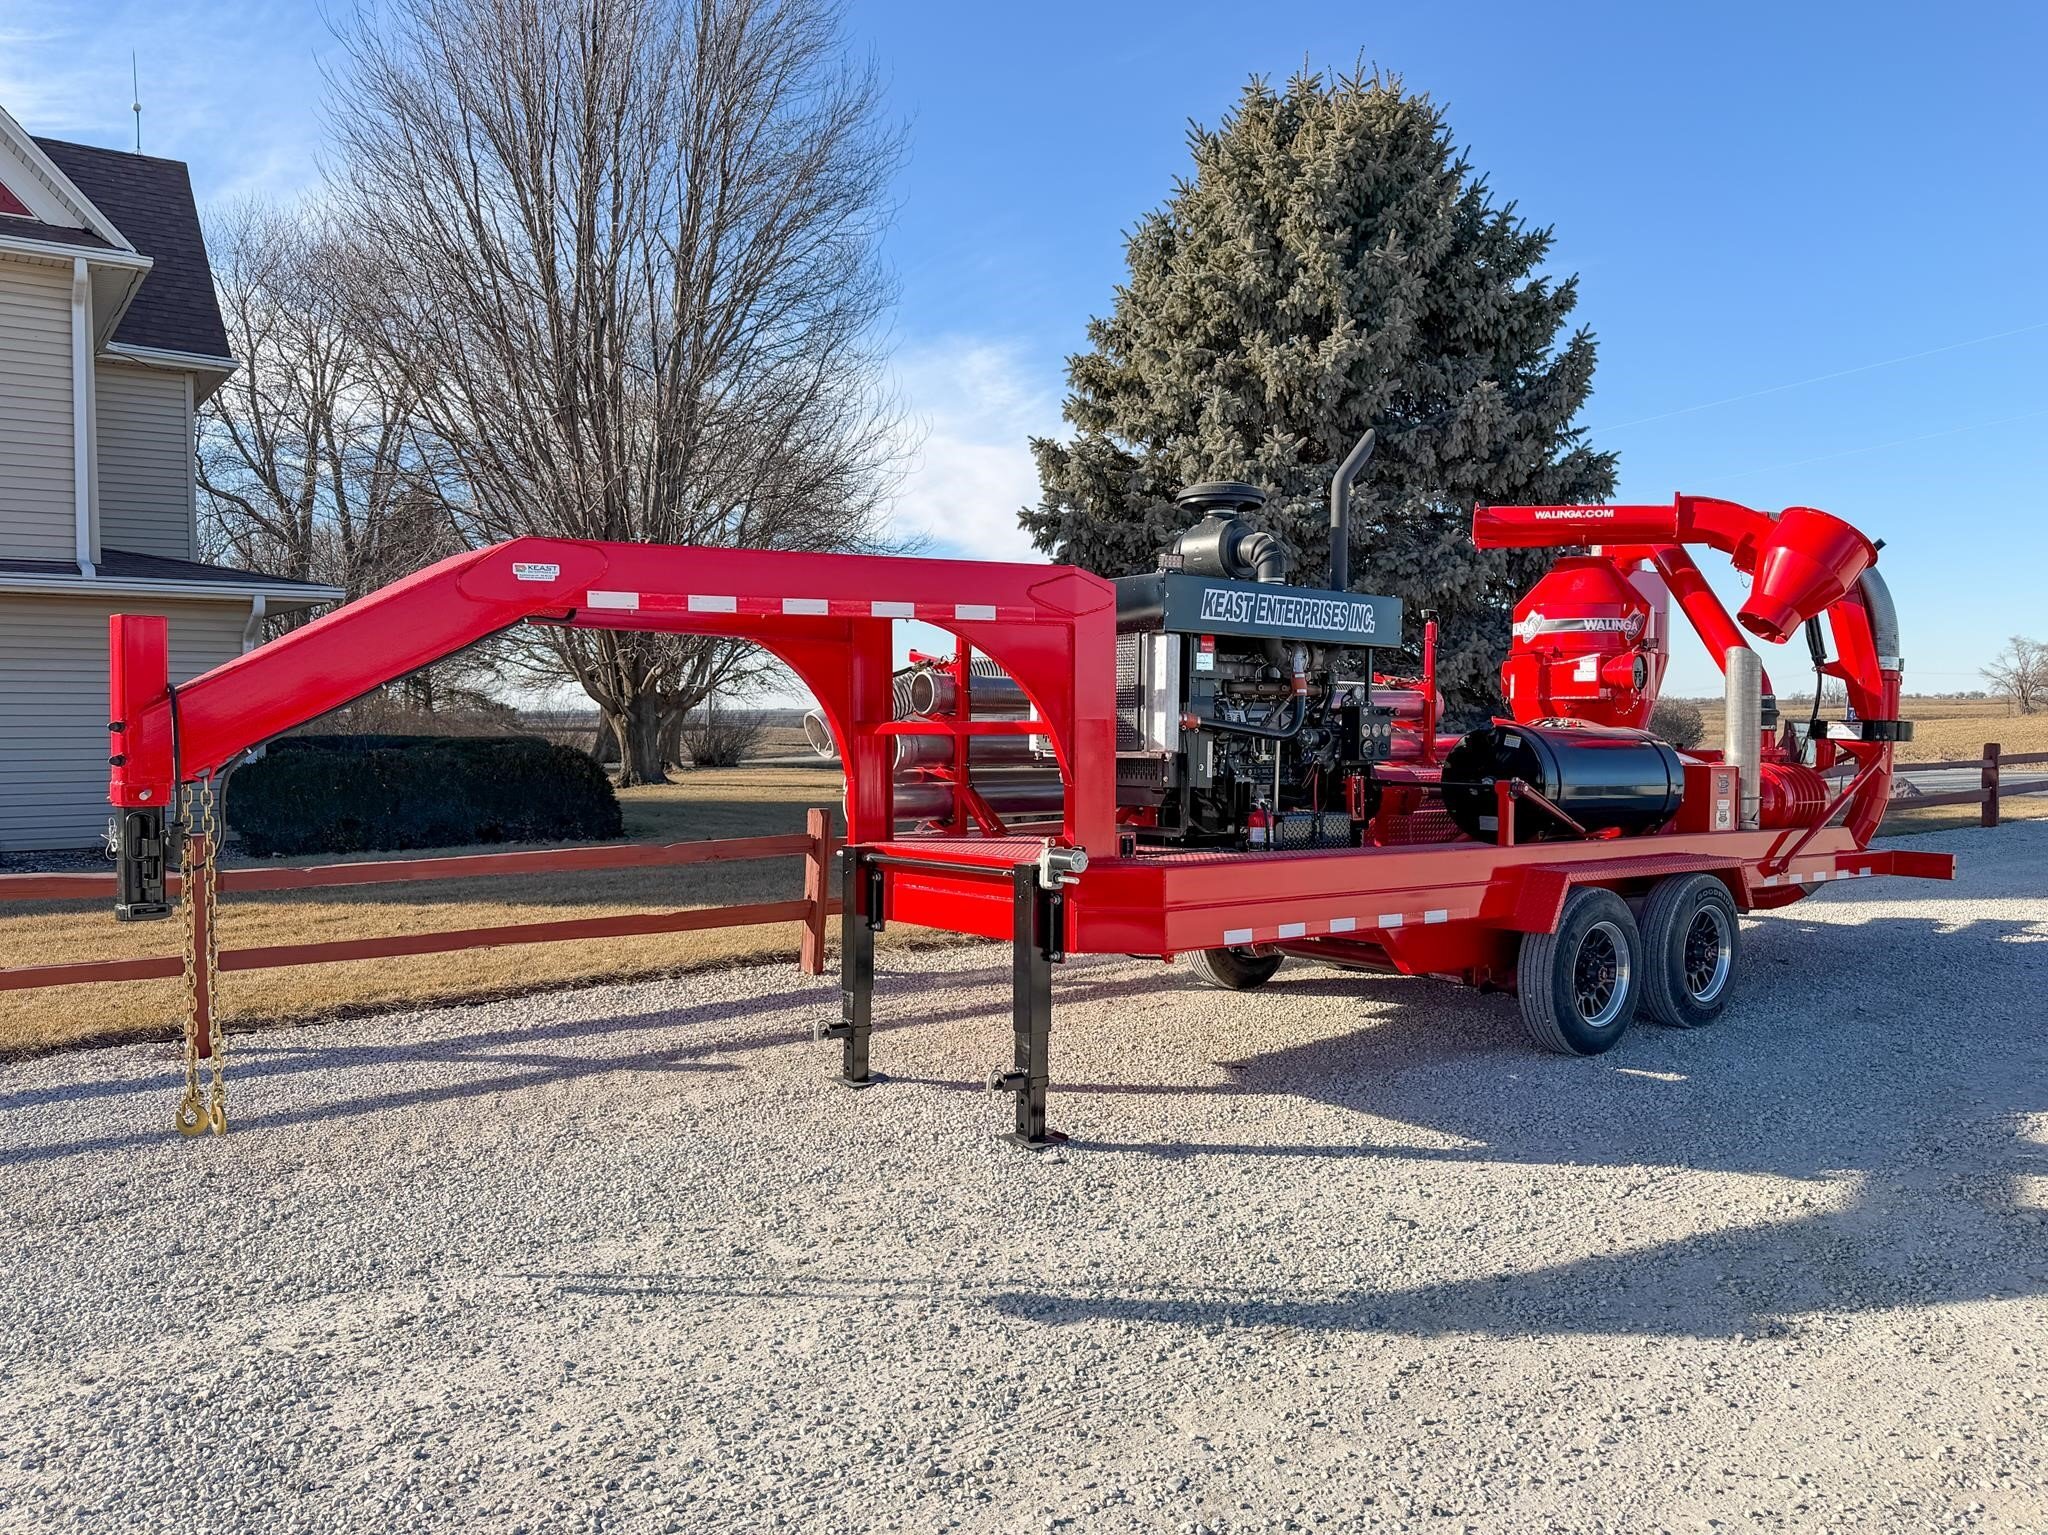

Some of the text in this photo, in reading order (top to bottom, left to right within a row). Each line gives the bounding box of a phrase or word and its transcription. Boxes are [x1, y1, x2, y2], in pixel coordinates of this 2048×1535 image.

[1200, 588, 1375, 633] KEAST ENTERPRISES INC.
[1584, 619, 1639, 631] WALINGA
